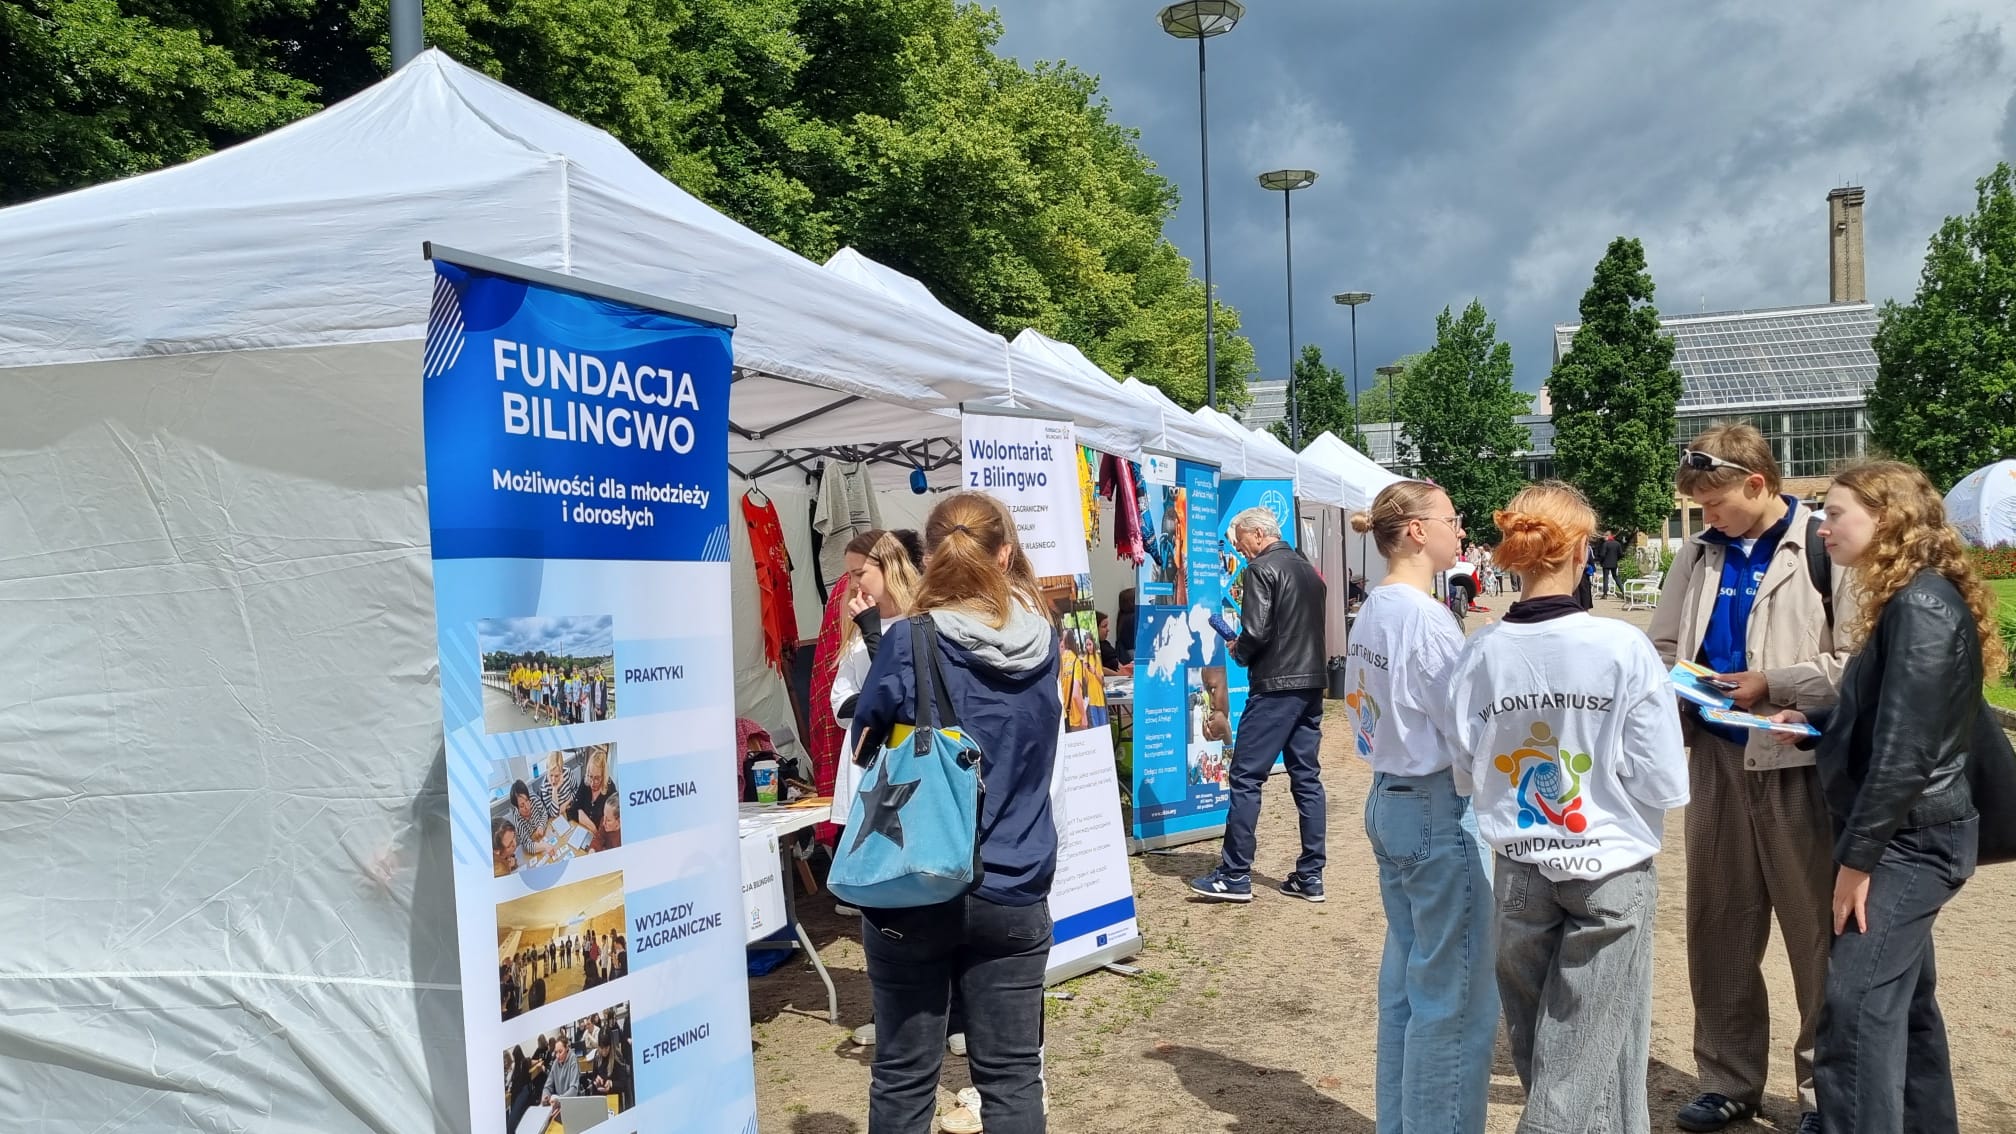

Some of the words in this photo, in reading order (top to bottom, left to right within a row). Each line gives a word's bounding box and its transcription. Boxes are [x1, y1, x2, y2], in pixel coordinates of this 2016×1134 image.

[493, 338, 699, 411] FUNDACJA
[502, 391, 695, 454] BILINGWO
[969, 439, 1053, 462] Wolontariat
[492, 469, 595, 497] Możliwości
[599, 477, 626, 499] dla
[631, 481, 710, 509] młodzieży
[969, 471, 979, 487] z
[983, 466, 1047, 491] Bilingwo
[562, 500, 568, 522] i
[573, 502, 654, 530] dorosłych
[1016, 523, 1036, 531] OKALNY
[625, 665, 684, 684] PRAKTYKI
[1478, 692, 1614, 723] WLONTARIUSZ
[629, 780, 697, 807] SZKOLENIA
[1504, 837, 1601, 859] FUNDACJA
[635, 901, 694, 933] WYJAZDY
[636, 912, 722, 953] ZAGRANICZNE
[642, 1022, 710, 1065] E-TRENINGI
